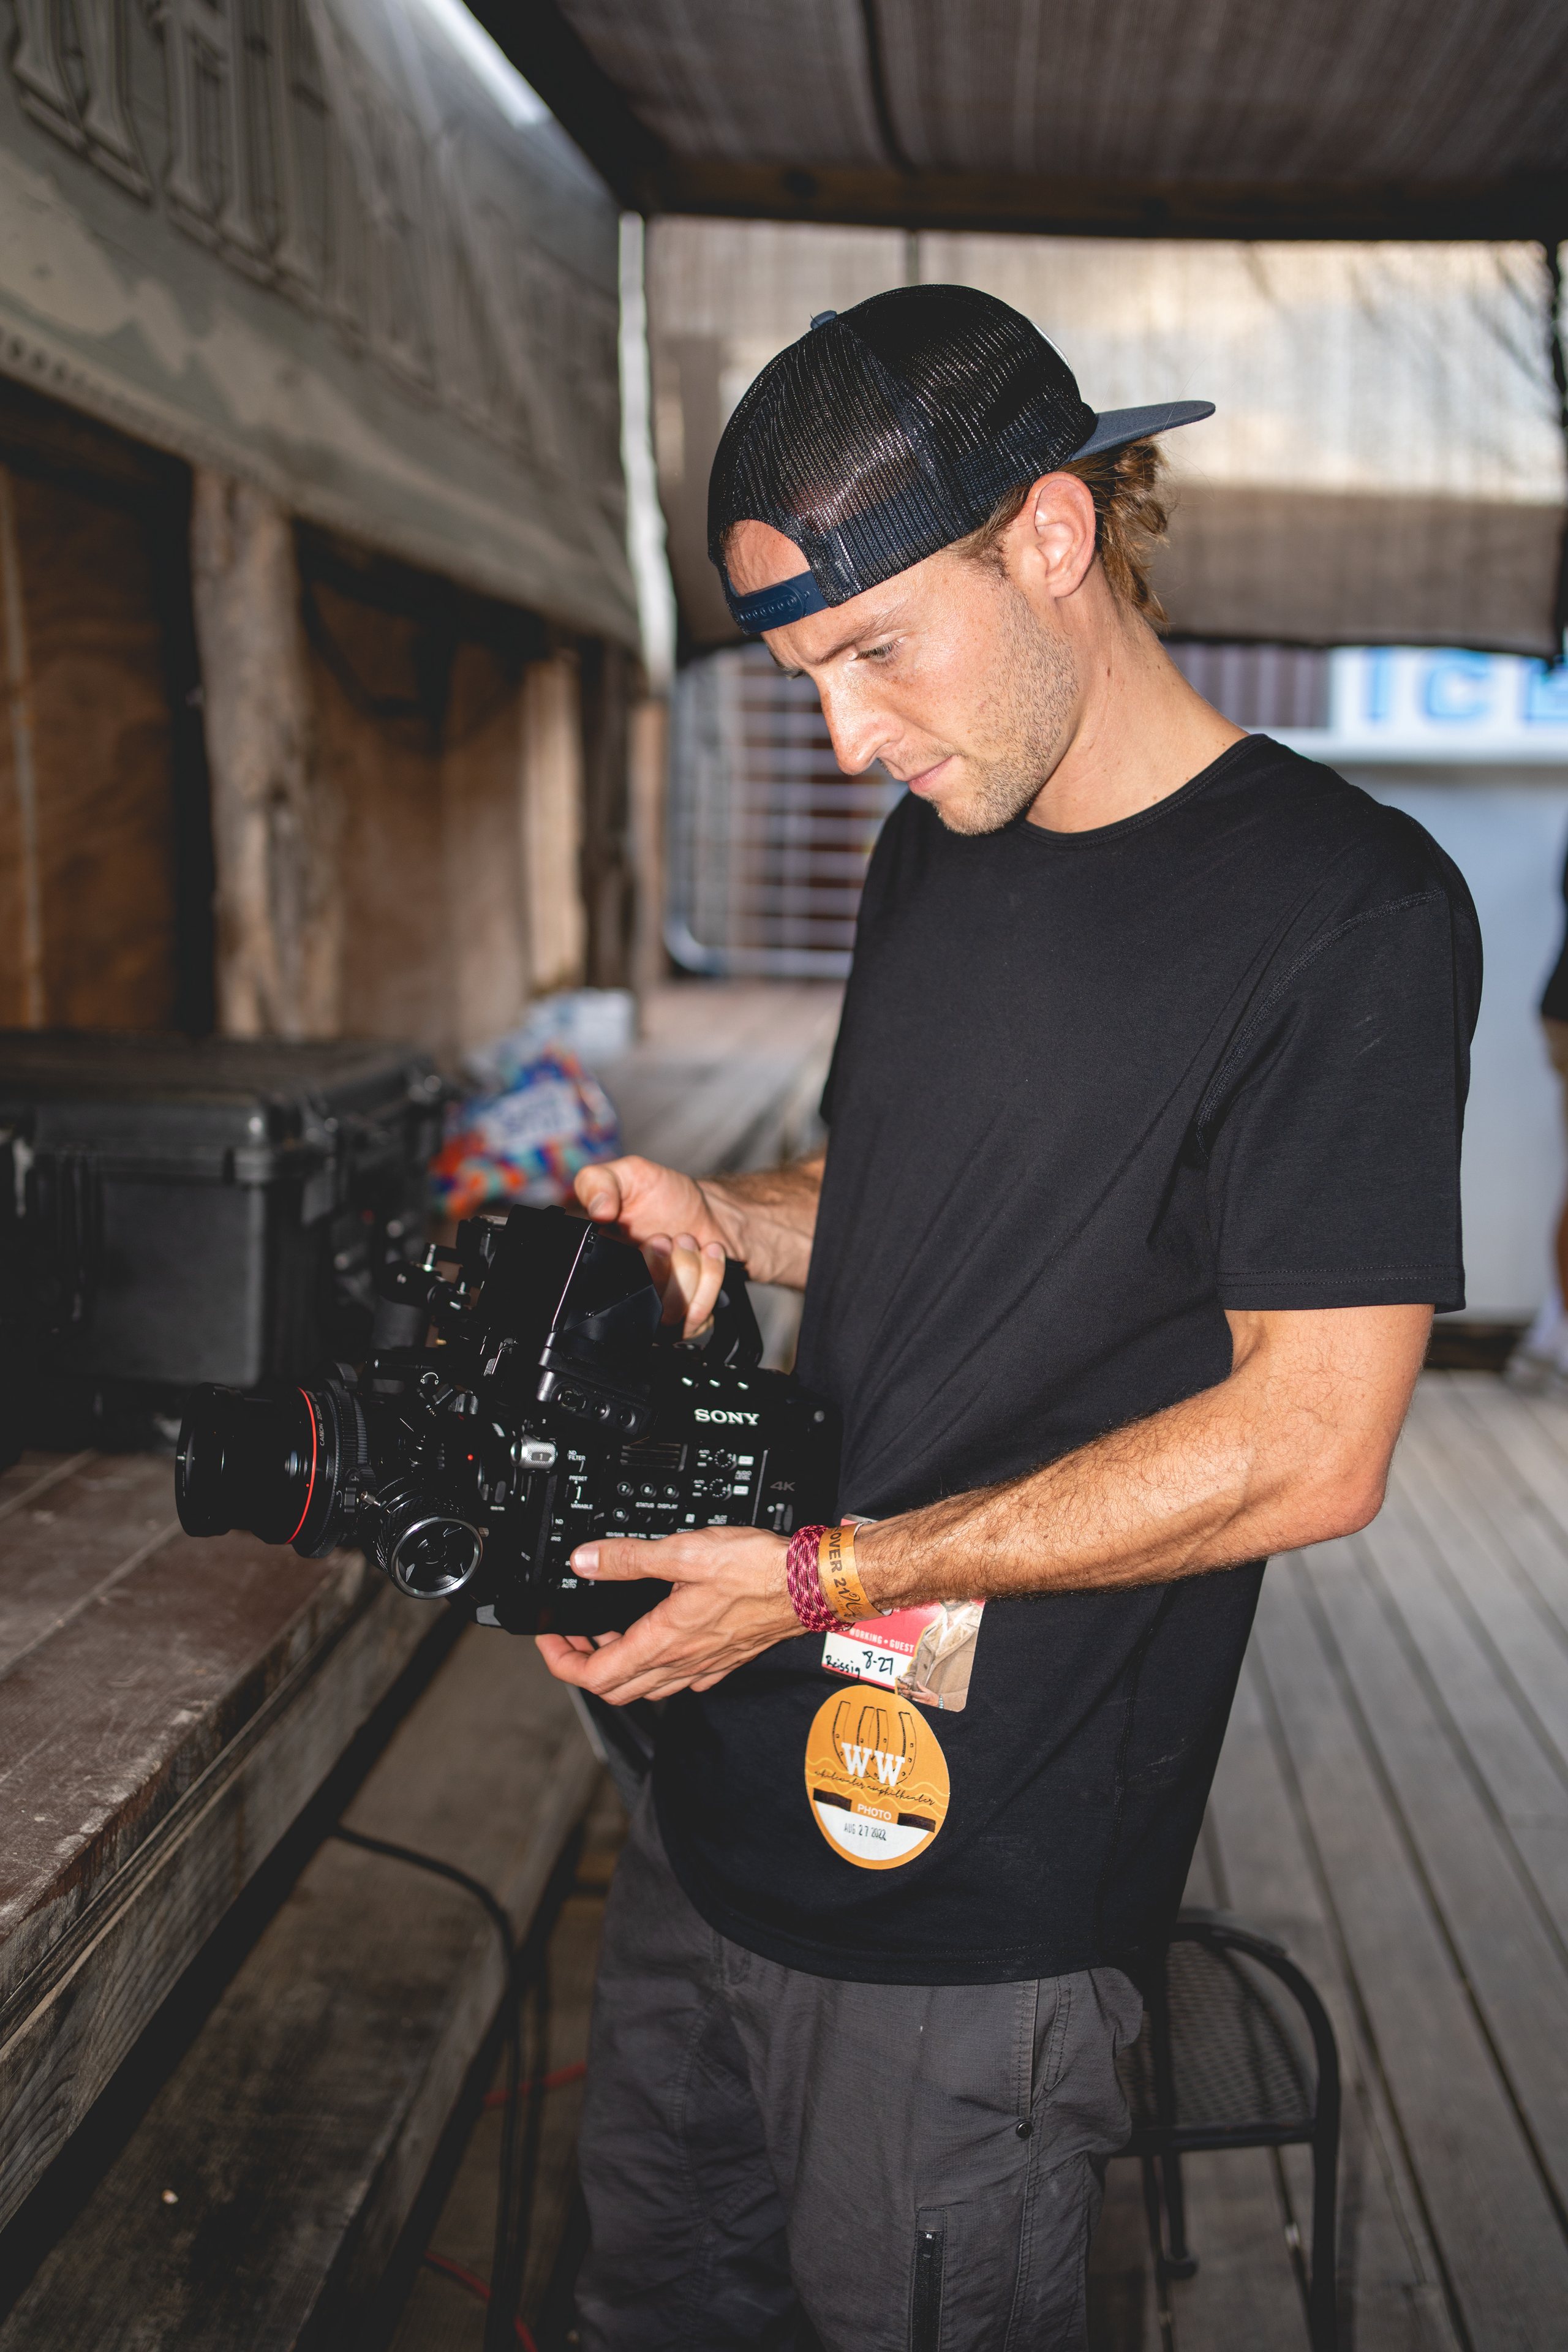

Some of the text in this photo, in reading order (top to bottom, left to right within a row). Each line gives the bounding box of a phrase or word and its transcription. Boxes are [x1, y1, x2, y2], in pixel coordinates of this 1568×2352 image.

[694, 1409, 760, 1426] SONY
[770, 1481, 796, 1491] 4K
[829, 1532, 850, 1594] OVER 21
[849, 1627, 915, 1653] WORKING GUEST
[862, 1650, 894, 1676] 8-27
[840, 1742, 906, 1787] WW
[867, 1778, 935, 1806] amphitheater
[858, 1803, 892, 1820] PHOTO
[844, 1823, 856, 1834] AUG
